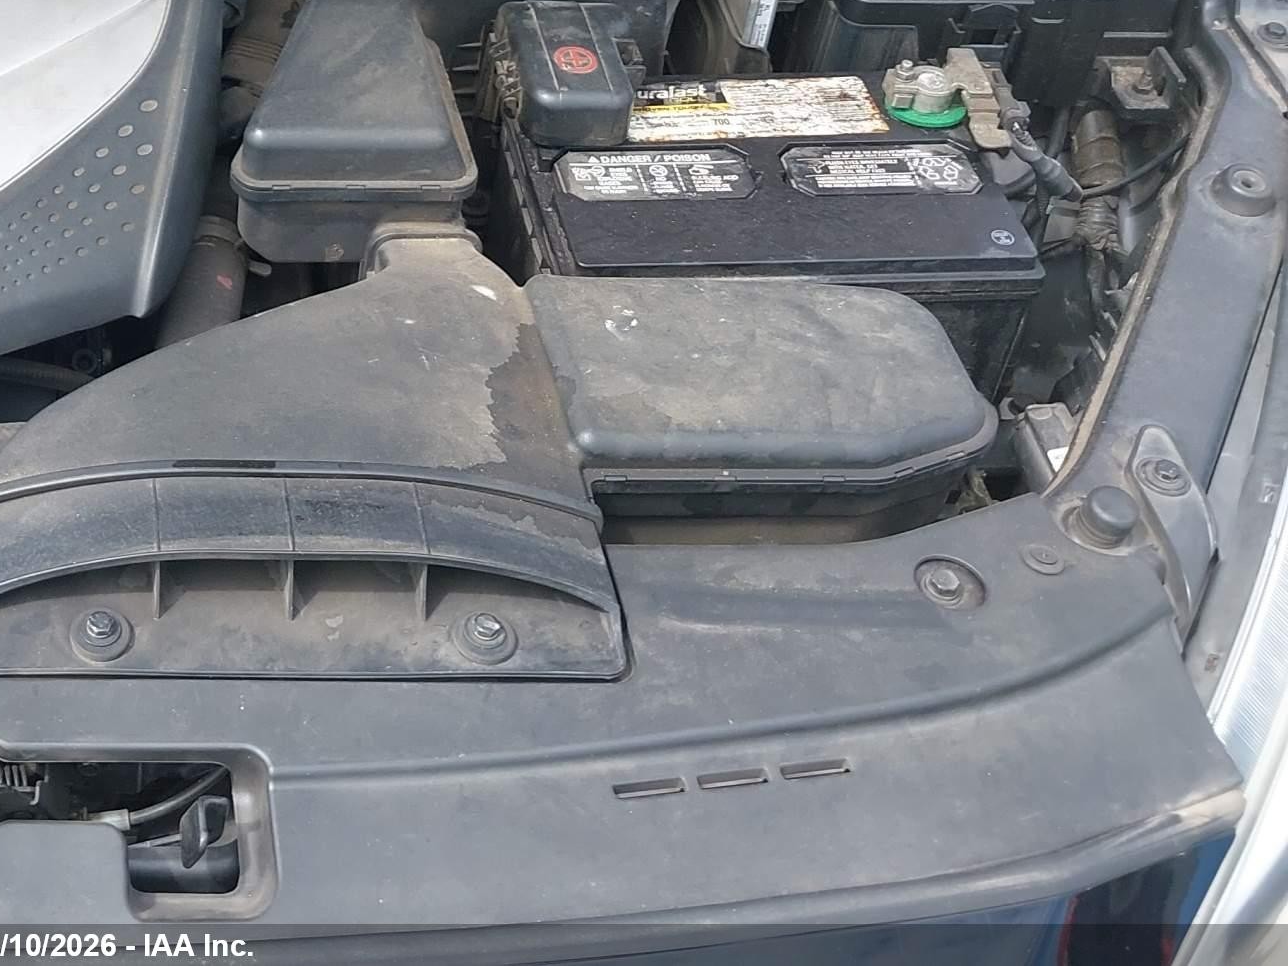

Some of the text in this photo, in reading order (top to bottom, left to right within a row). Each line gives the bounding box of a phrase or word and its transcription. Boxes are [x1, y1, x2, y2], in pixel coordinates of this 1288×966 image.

[636, 84, 707, 99] uralast
[600, 155, 652, 163] DANGER
[664, 154, 711, 162] POISON
